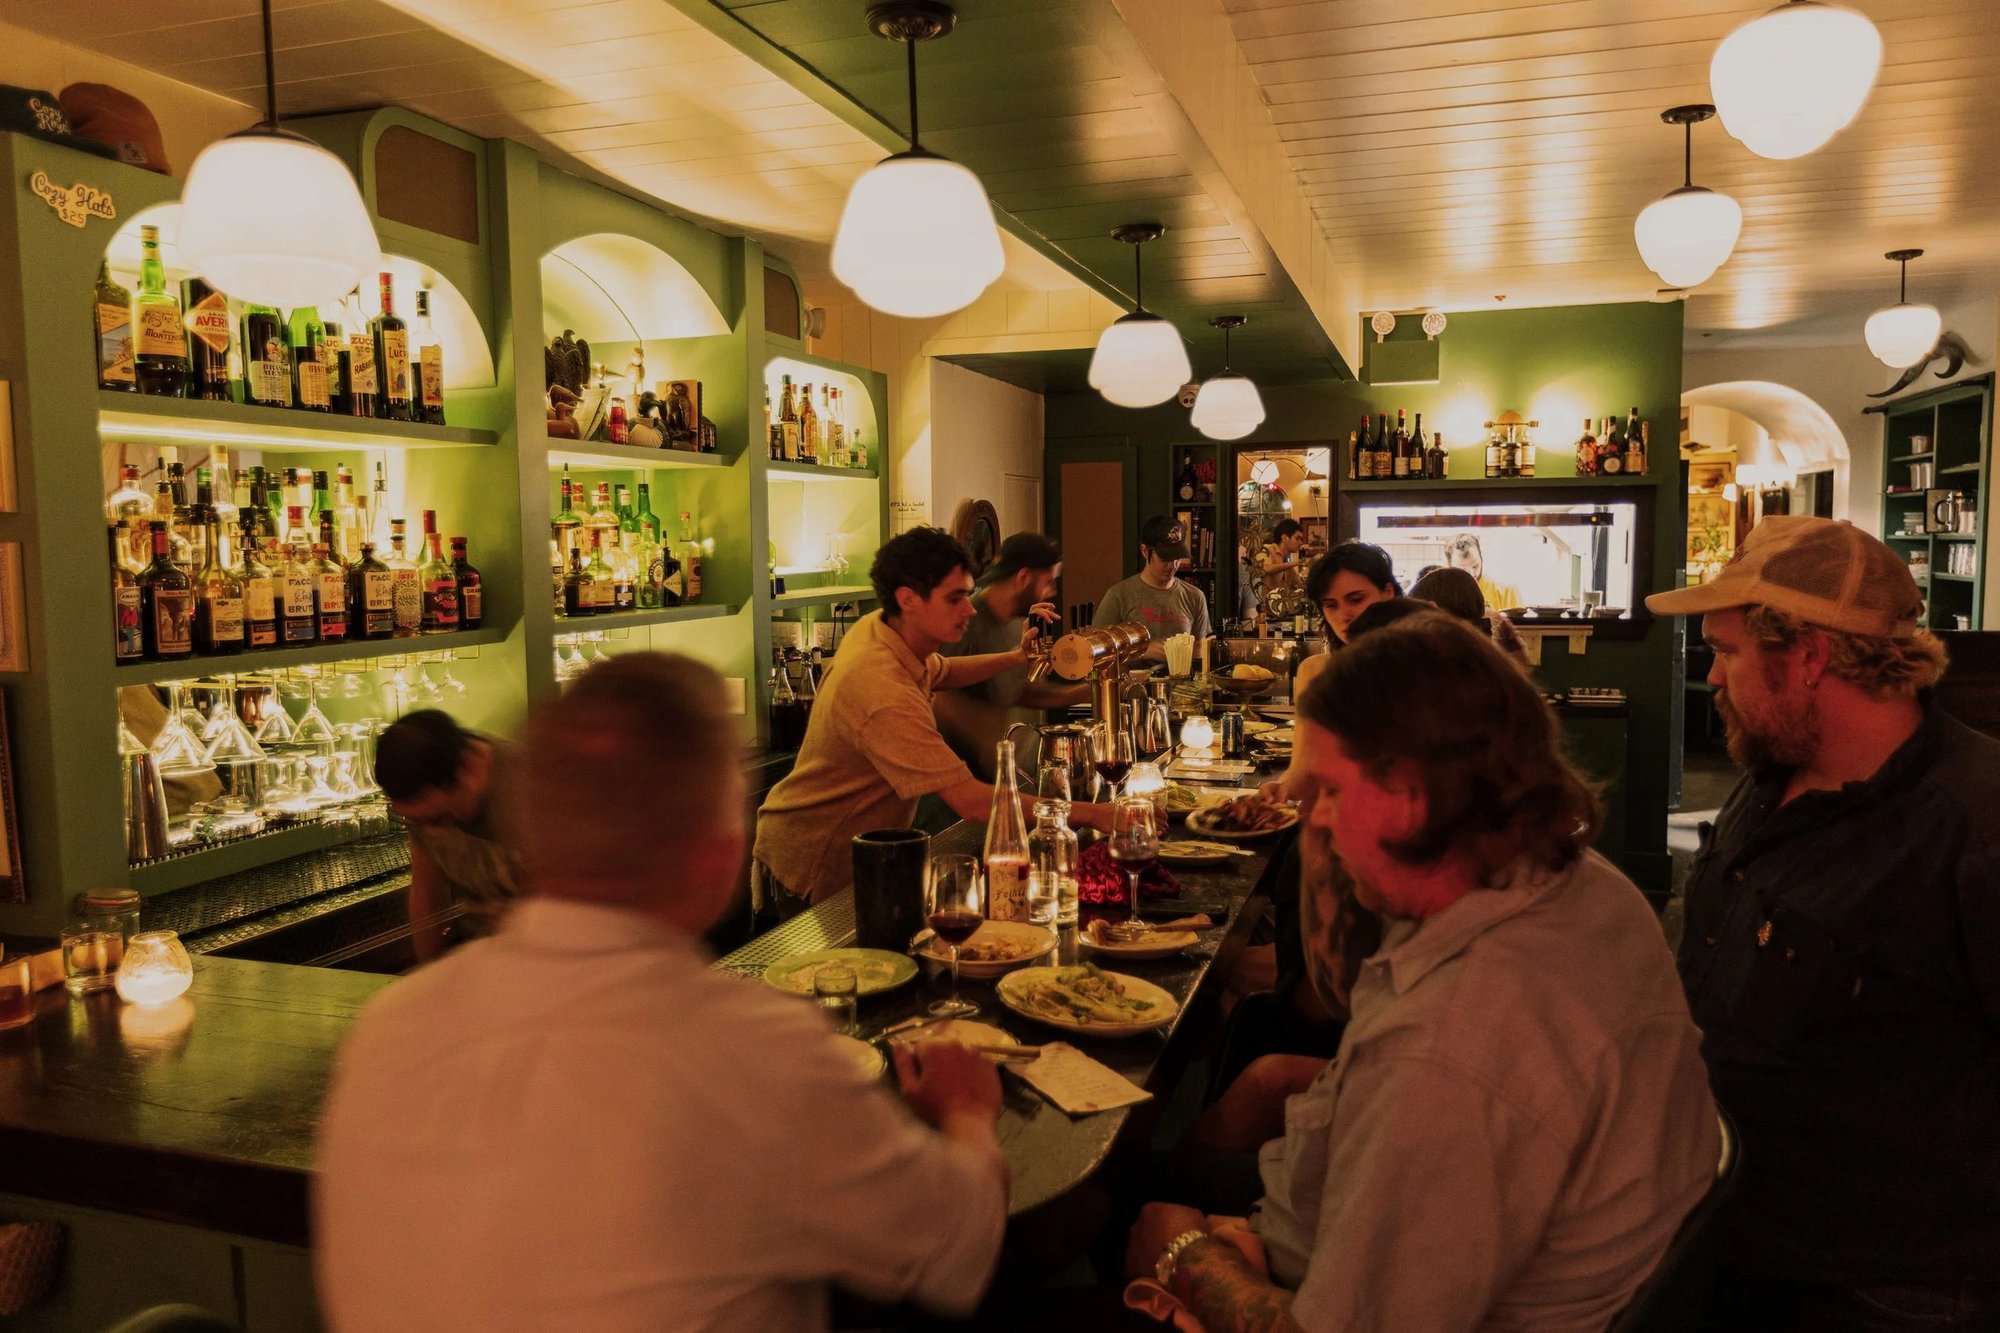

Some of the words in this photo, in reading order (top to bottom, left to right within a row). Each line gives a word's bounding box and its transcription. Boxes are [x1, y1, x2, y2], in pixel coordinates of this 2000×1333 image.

[28, 97, 63, 122] Cozy
[34, 174, 69, 207] Cozy
[76, 186, 113, 216] Hats
[61, 208, 84, 224] $25
[195, 315, 227, 328] AVER
[351, 337, 374, 345] ZUC
[354, 360, 374, 375] RABAR
[288, 578, 311, 586] FACC
[288, 605, 313, 613] BRUT
